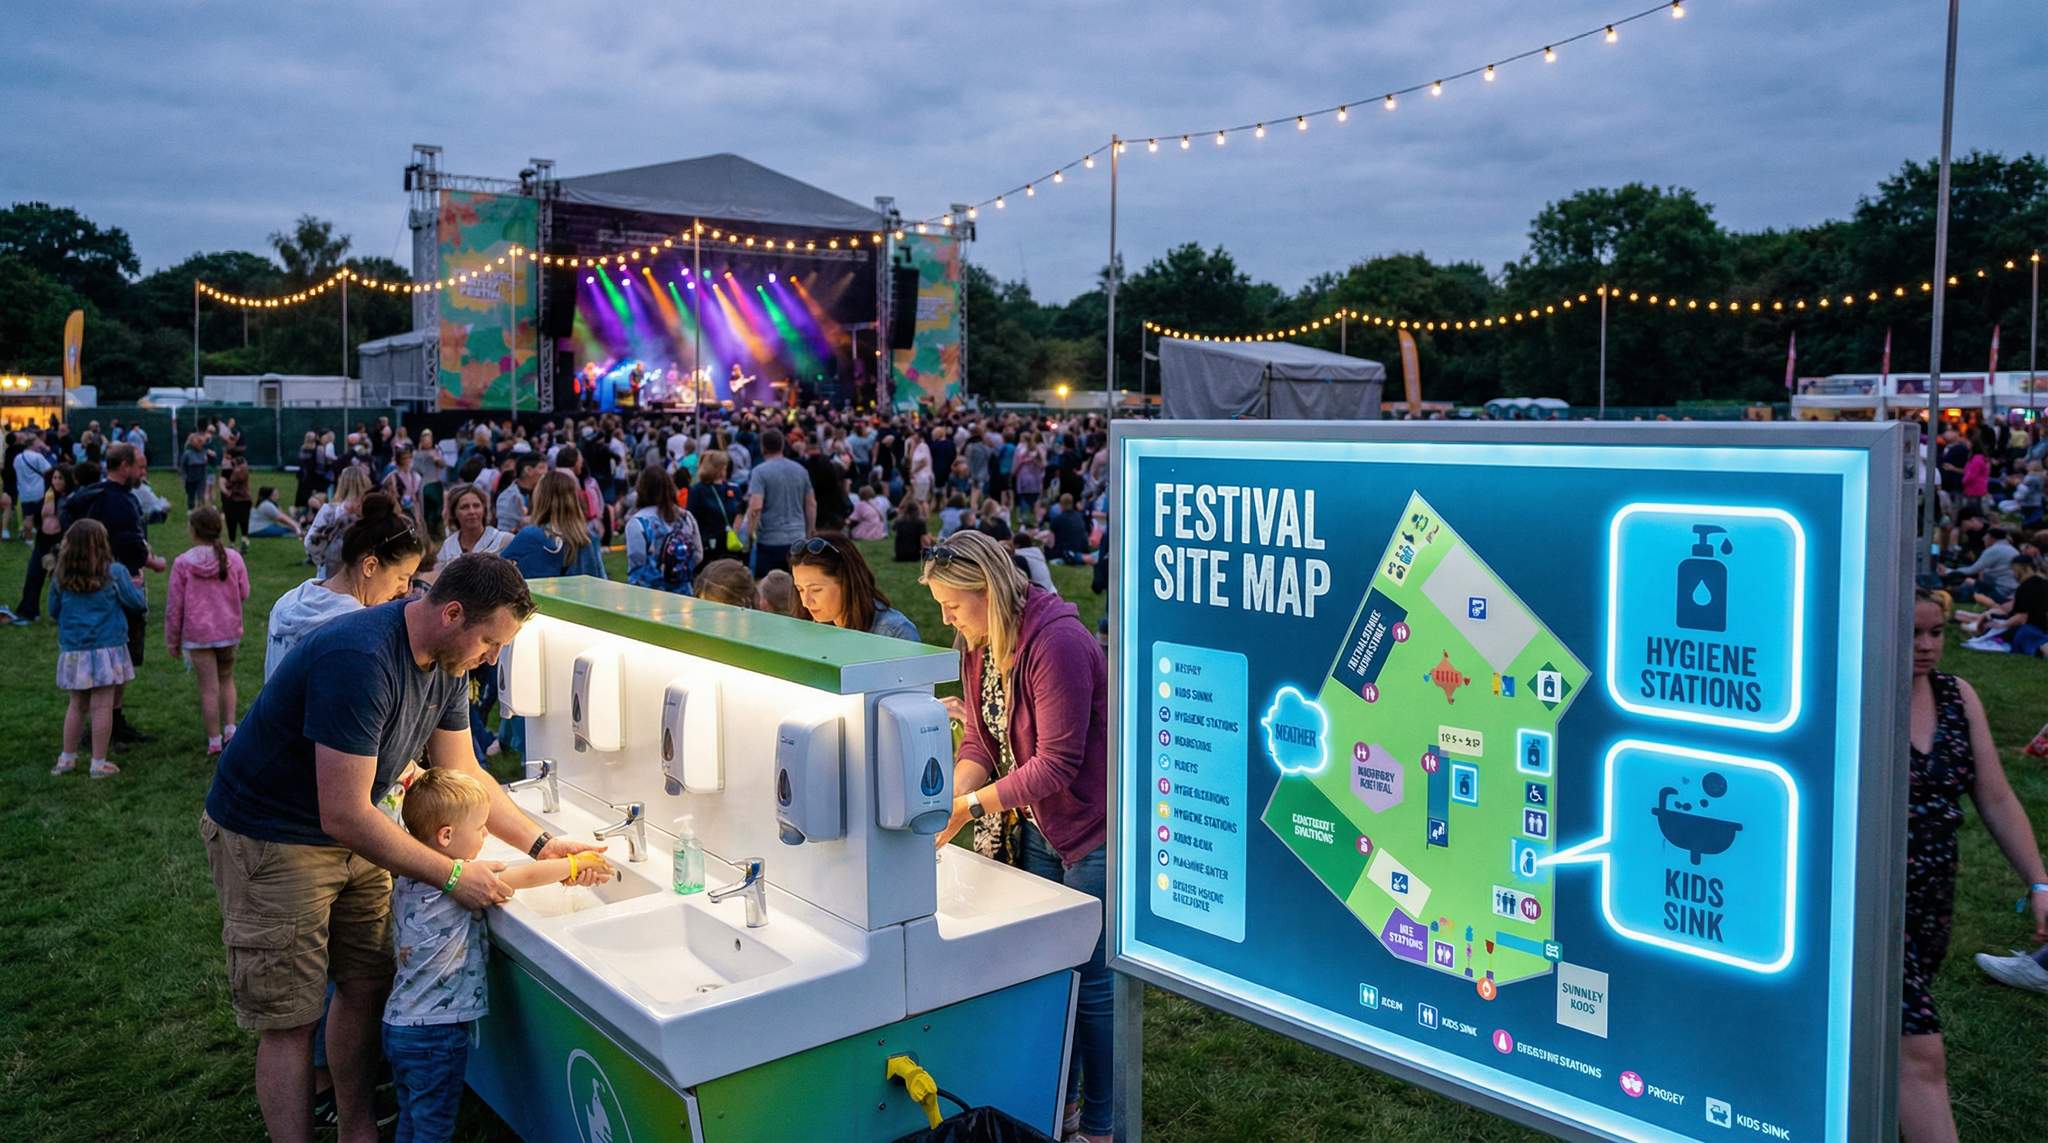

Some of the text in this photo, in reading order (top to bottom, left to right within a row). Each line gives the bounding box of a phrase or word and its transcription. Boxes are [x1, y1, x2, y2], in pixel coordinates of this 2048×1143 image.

[1155, 482, 1326, 550] FESTIVAL
[1153, 544, 1332, 618] SITE MAP
[1646, 635, 1757, 678] HYGIENE
[1640, 668, 1762, 713] STATIONS
[1664, 867, 1725, 909] KIDS
[1662, 900, 1724, 943] SINK
[1559, 1055, 1602, 1079] STATIONS
[1736, 1113, 1790, 1141] KIDS SINK
